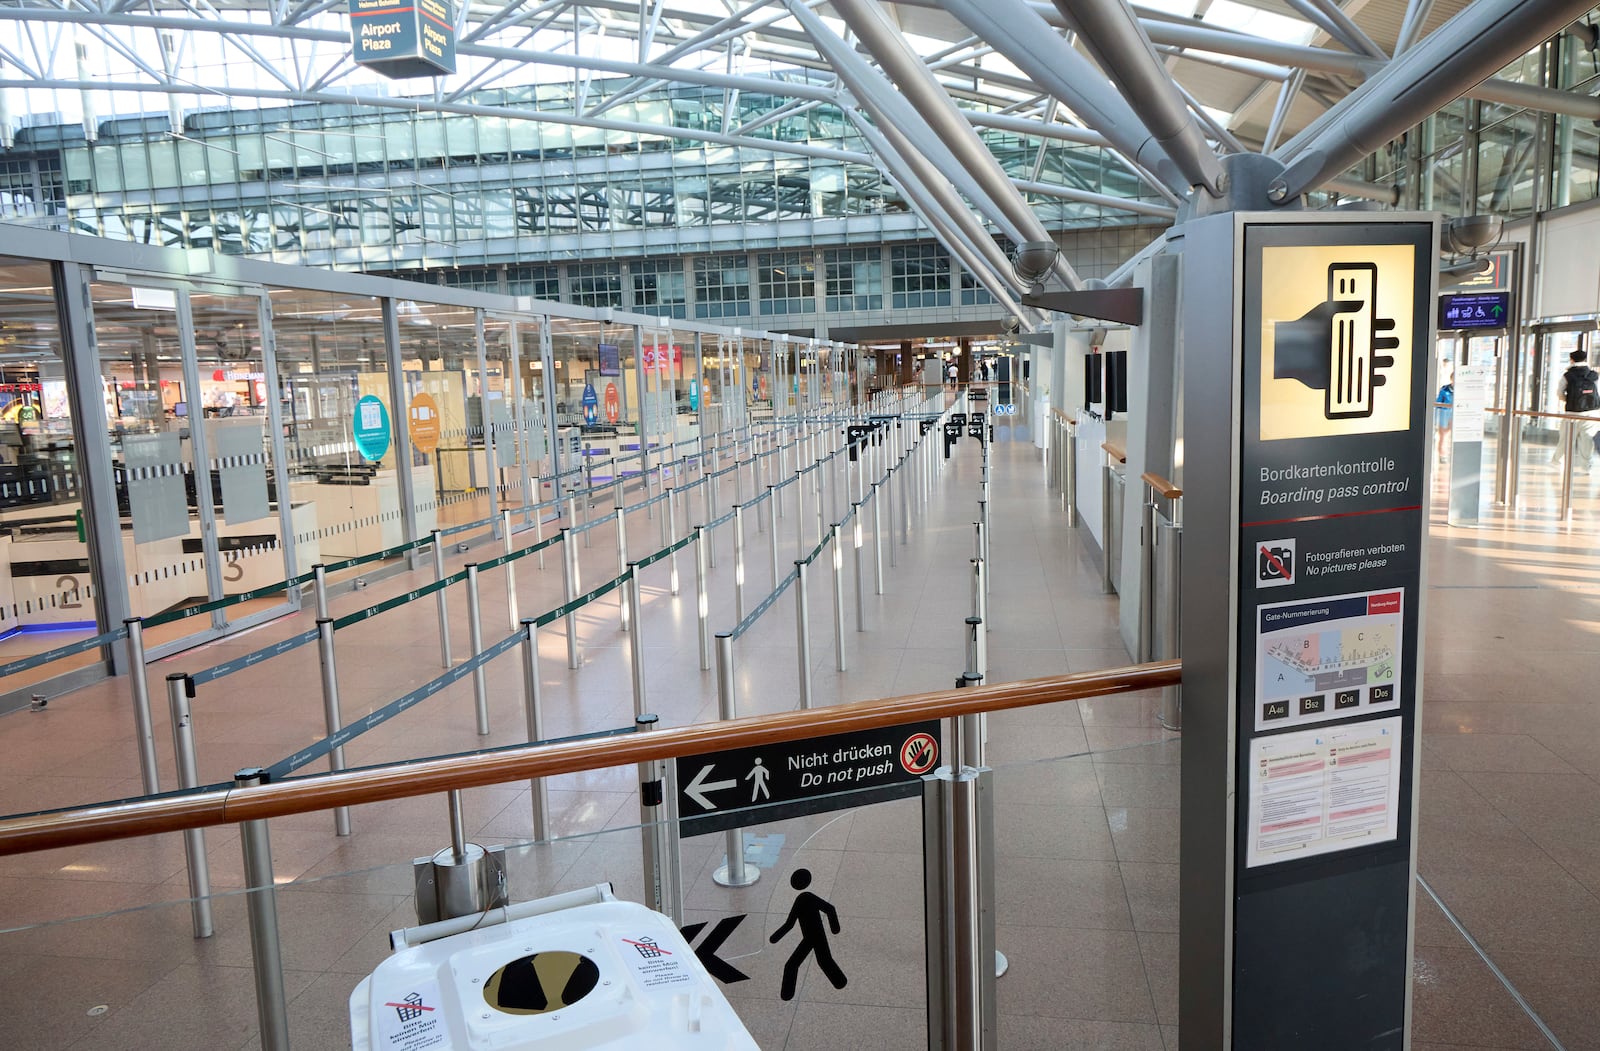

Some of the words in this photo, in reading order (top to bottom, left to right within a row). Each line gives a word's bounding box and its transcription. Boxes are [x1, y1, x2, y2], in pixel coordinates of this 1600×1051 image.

[361, 21, 401, 37] Airport
[423, 23, 447, 46] Airport
[362, 38, 391, 51] Plaza
[424, 37, 442, 57] Plaza
[1260, 457, 1395, 482] Bordkartenkontrolle
[1260, 487, 1325, 505] Boarding
[1327, 485, 1359, 502] pass
[1362, 477, 1410, 496] control
[1305, 548, 1365, 563] Fotografieren
[1367, 543, 1405, 555] verboten
[1305, 566, 1319, 576] No
[1321, 562, 1357, 576] pictures
[1358, 558, 1387, 571] please
[1265, 607, 1330, 622] Gate-Nummerierung
[1304, 640, 1310, 649] B
[1358, 632, 1364, 641] C
[1277, 673, 1284, 682] A
[1386, 670, 1392, 678] D
[1340, 693, 1354, 704] C16
[1374, 688, 1389, 699] D05
[788, 752, 828, 771] Nicht
[832, 744, 892, 764] drücken
[800, 772, 822, 788] Do
[827, 767, 853, 784] not
[856, 759, 893, 781] push
